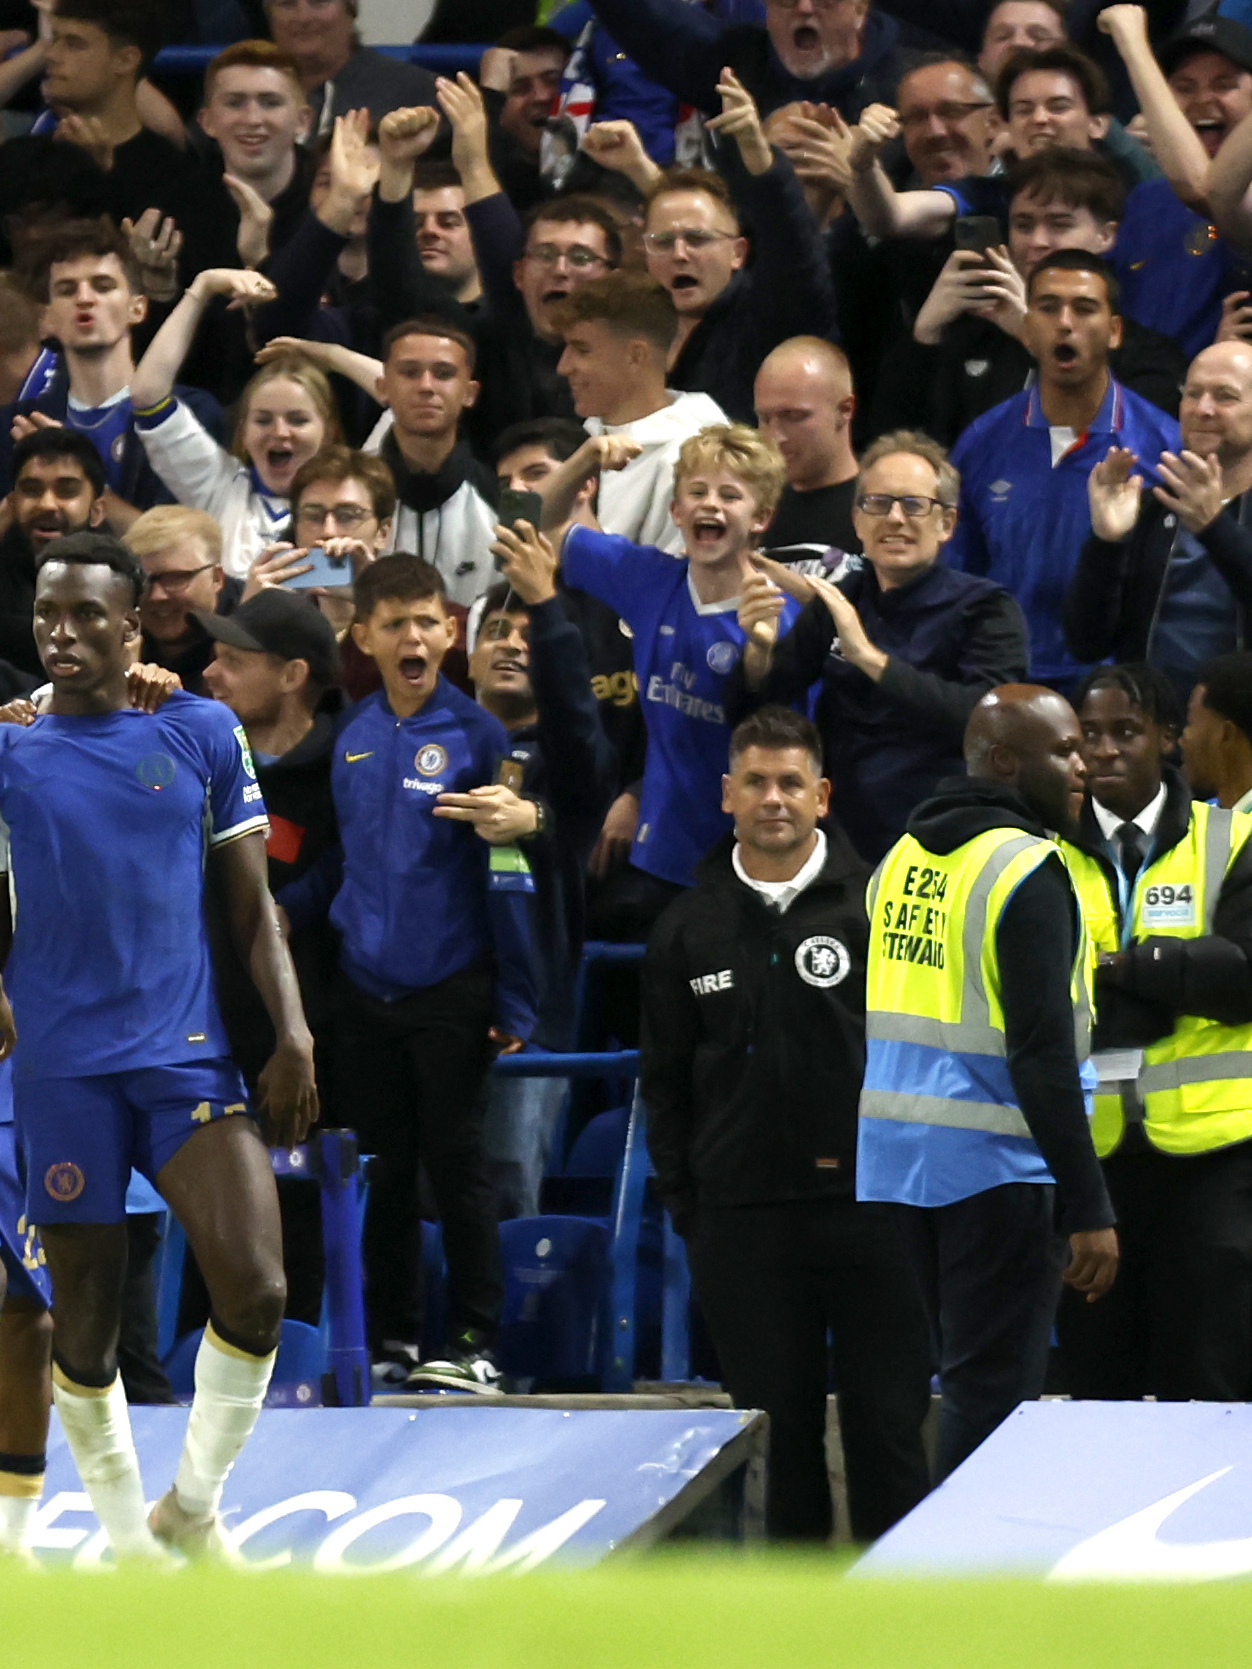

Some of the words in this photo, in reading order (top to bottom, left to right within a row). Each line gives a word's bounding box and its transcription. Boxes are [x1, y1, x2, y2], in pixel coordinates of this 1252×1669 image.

[403, 777, 445, 795] trivago
[1145, 885, 1192, 905] 694
[689, 969, 734, 996] FIRE
